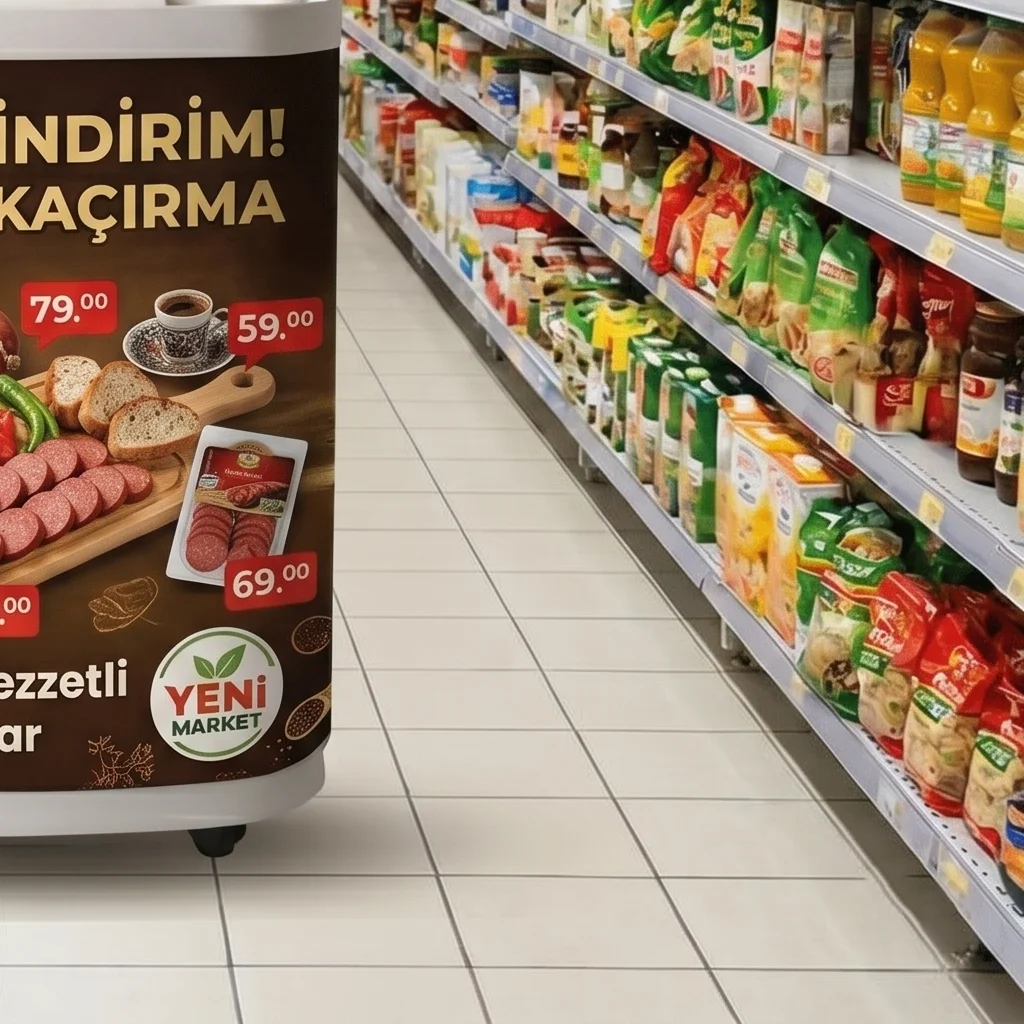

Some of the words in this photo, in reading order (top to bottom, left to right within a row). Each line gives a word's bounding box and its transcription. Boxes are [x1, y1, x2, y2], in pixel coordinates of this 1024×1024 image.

[30, 292, 108, 323] 79.00
[236, 309, 315, 344] 59.00
[233, 563, 309, 598] 69.00
[172, 712, 262, 736] MARKET
